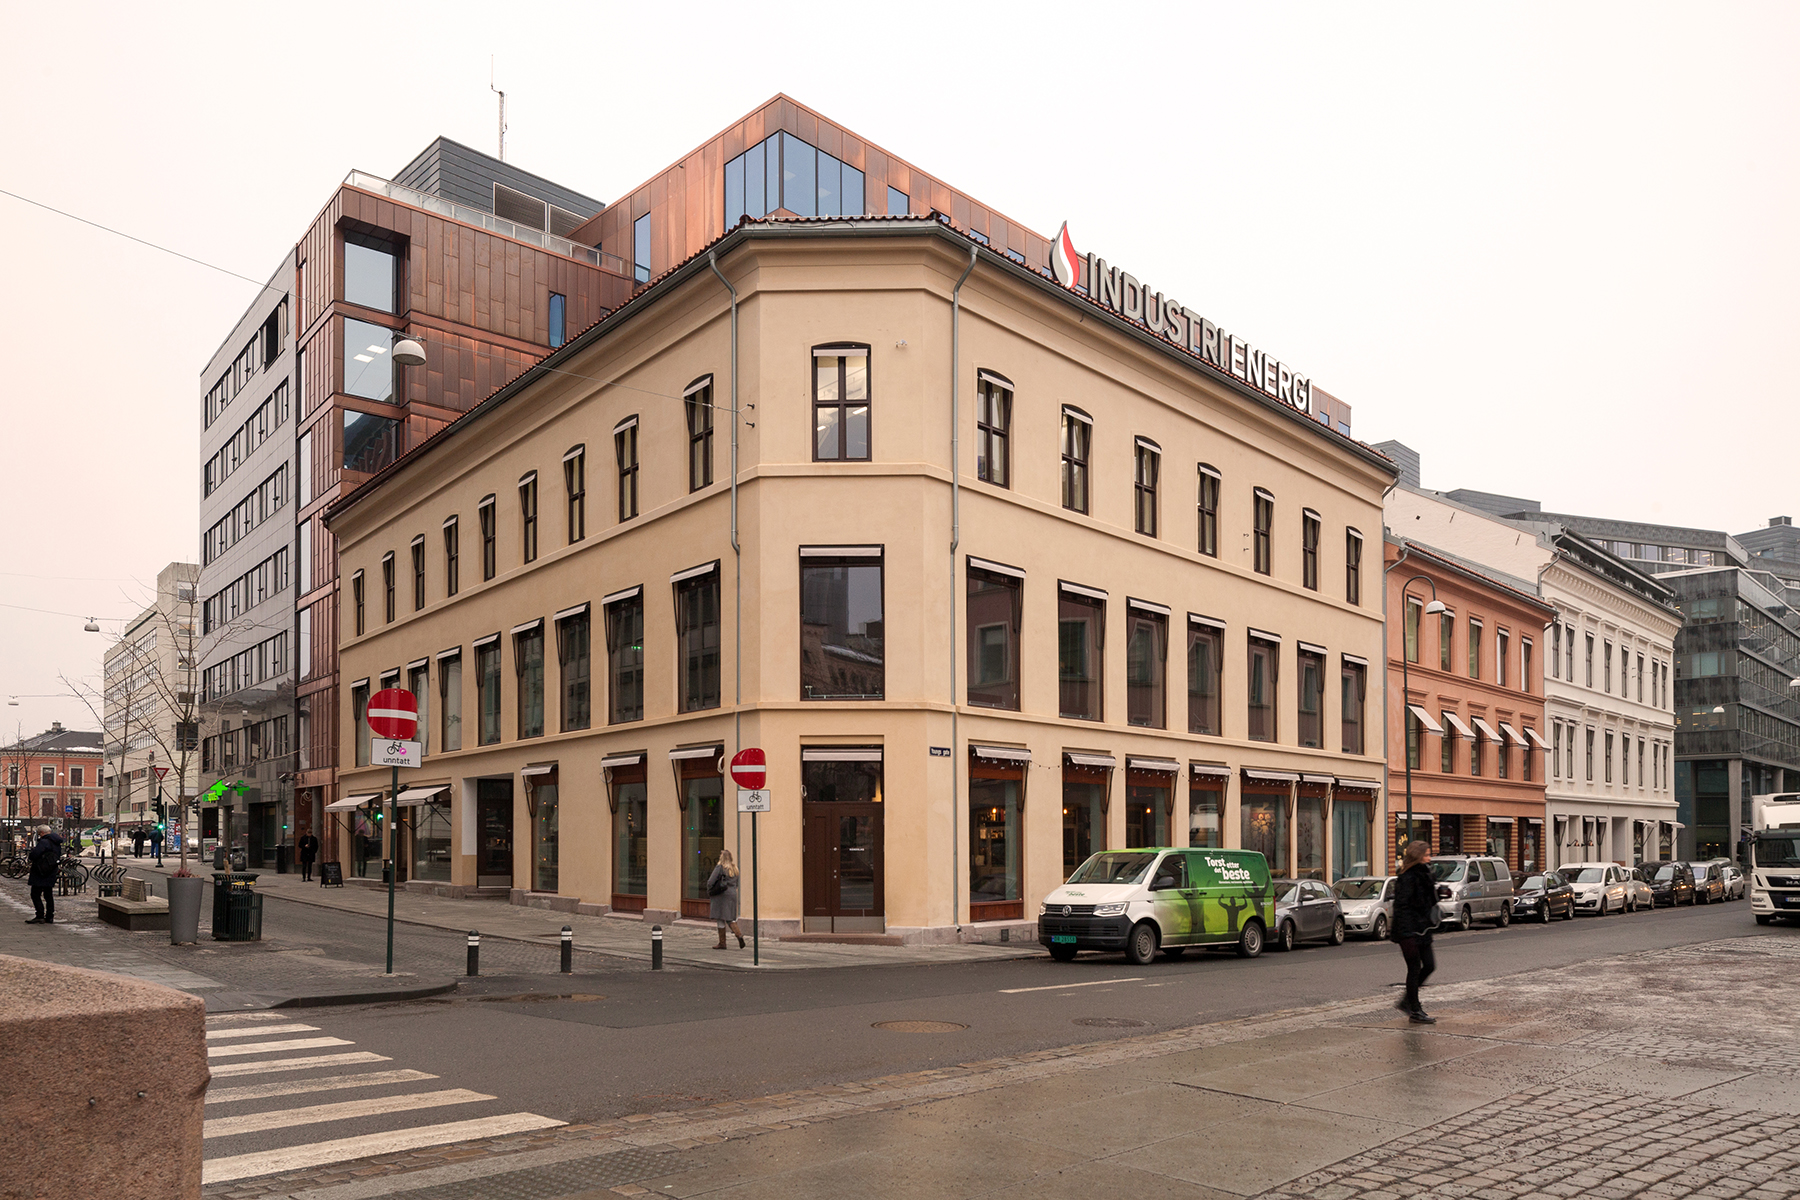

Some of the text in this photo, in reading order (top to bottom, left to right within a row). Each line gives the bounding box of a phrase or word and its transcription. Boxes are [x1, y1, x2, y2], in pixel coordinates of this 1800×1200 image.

[1087, 252, 1313, 415] INDUSTRIENERGI
[382, 757, 411, 765] unntatt
[1204, 856, 1226, 867] Torst
[1221, 866, 1251, 880] beste
